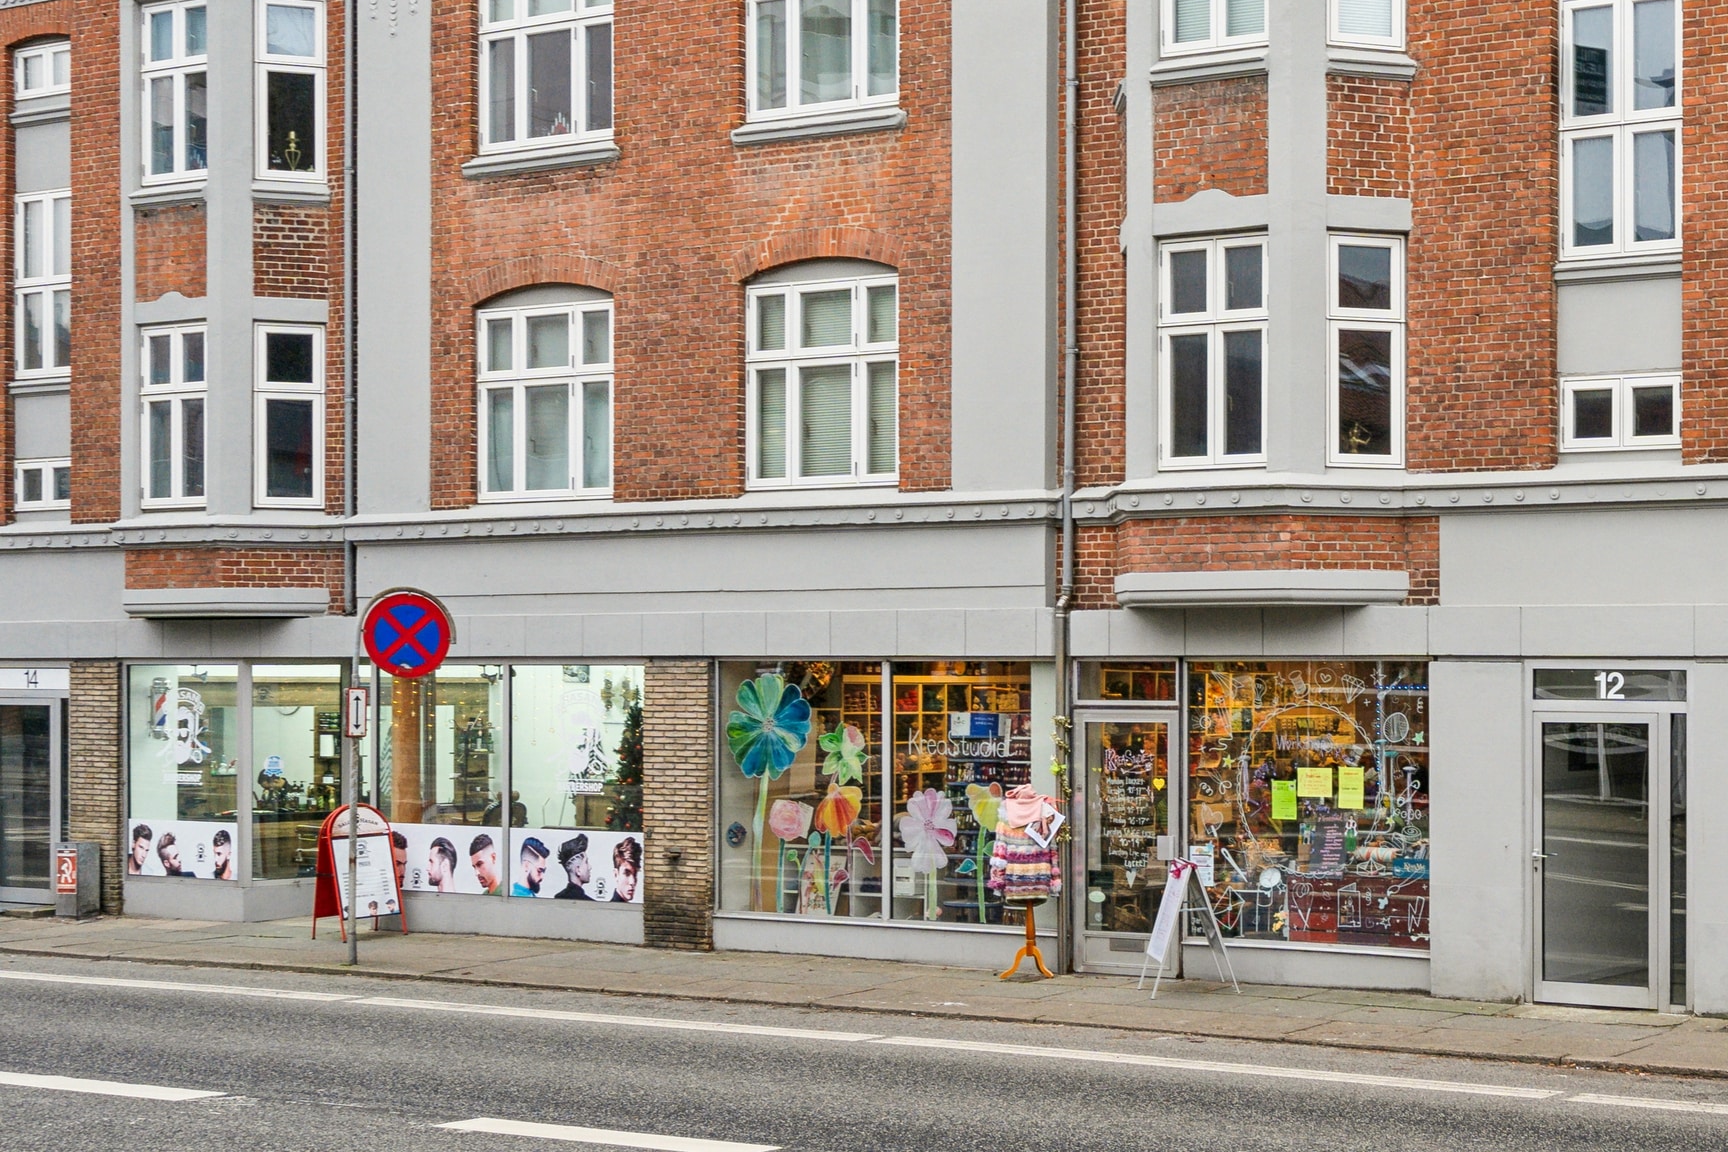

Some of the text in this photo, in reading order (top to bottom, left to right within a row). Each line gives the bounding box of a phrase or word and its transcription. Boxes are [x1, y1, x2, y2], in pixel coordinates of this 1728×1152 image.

[24, 669, 39, 688] 14
[1594, 671, 1625, 699] 12
[908, 728, 1015, 758] KreaStudiet
